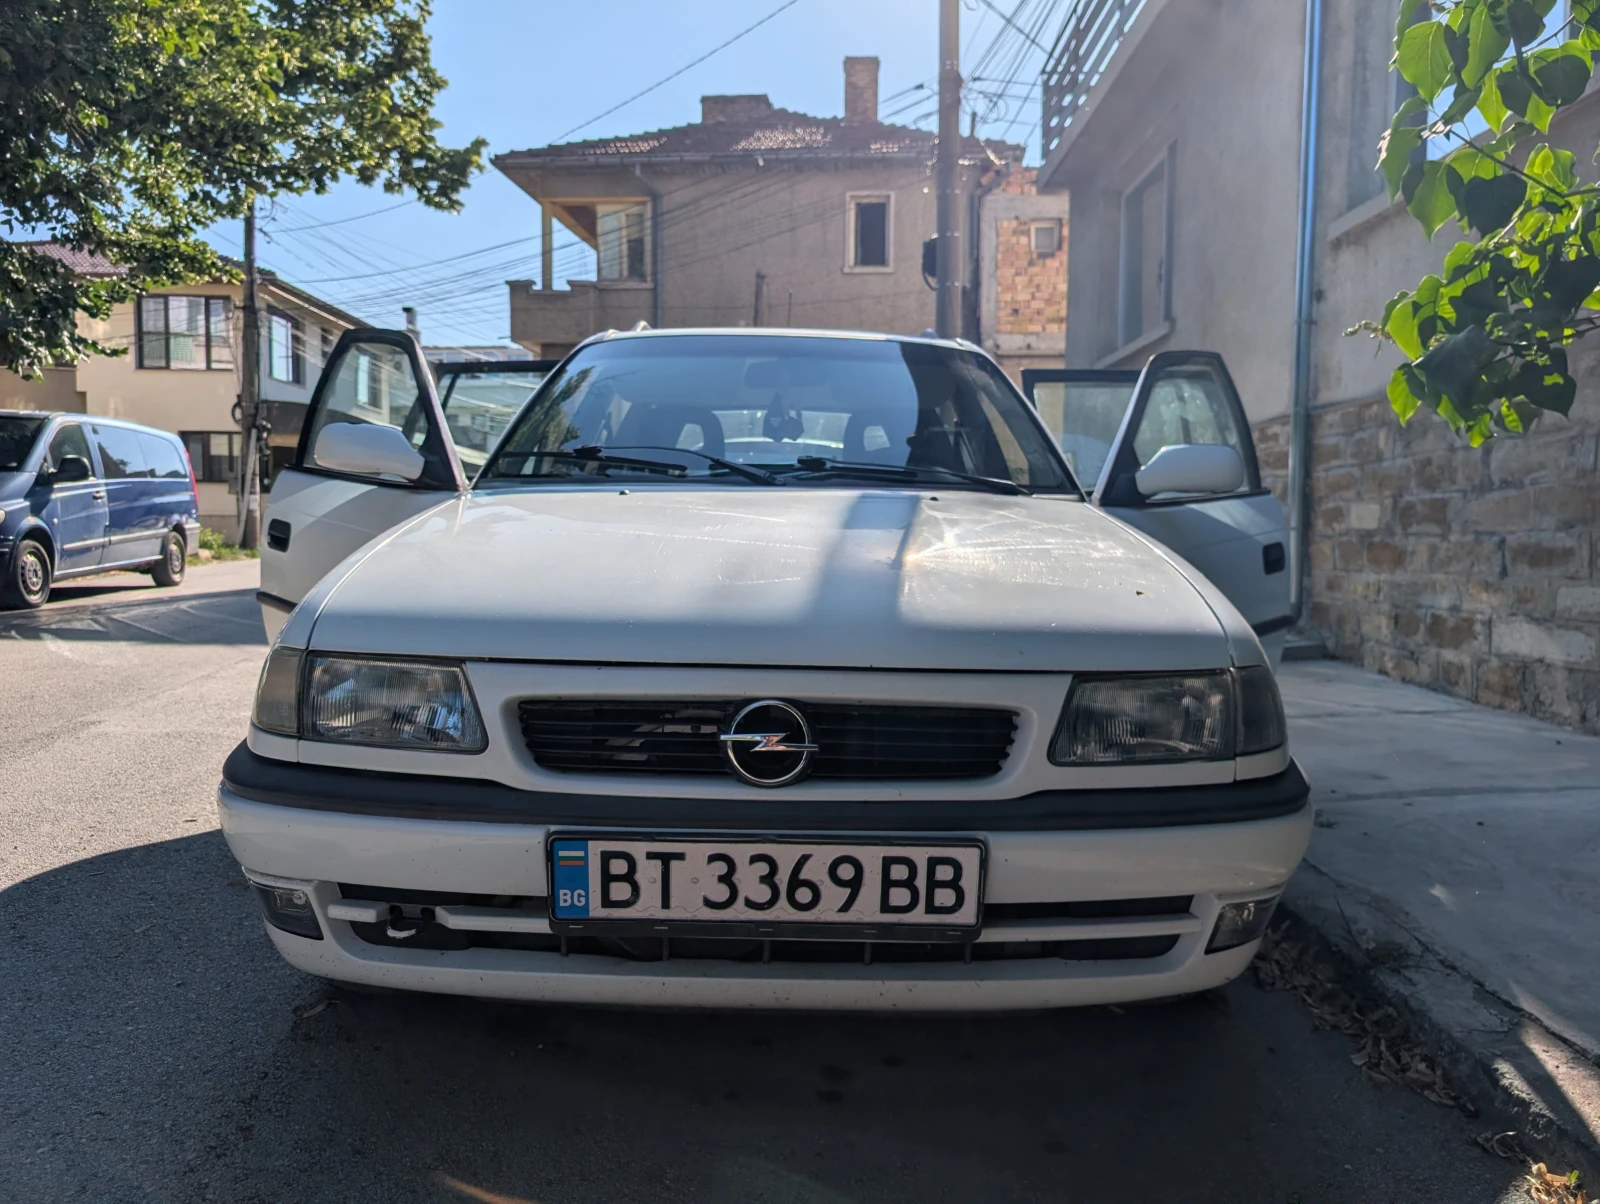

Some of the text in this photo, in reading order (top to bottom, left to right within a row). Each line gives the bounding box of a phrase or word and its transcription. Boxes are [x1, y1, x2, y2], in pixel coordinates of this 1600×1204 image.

[558, 889, 587, 907] BG
[599, 850, 966, 915] BT 3369 BB
